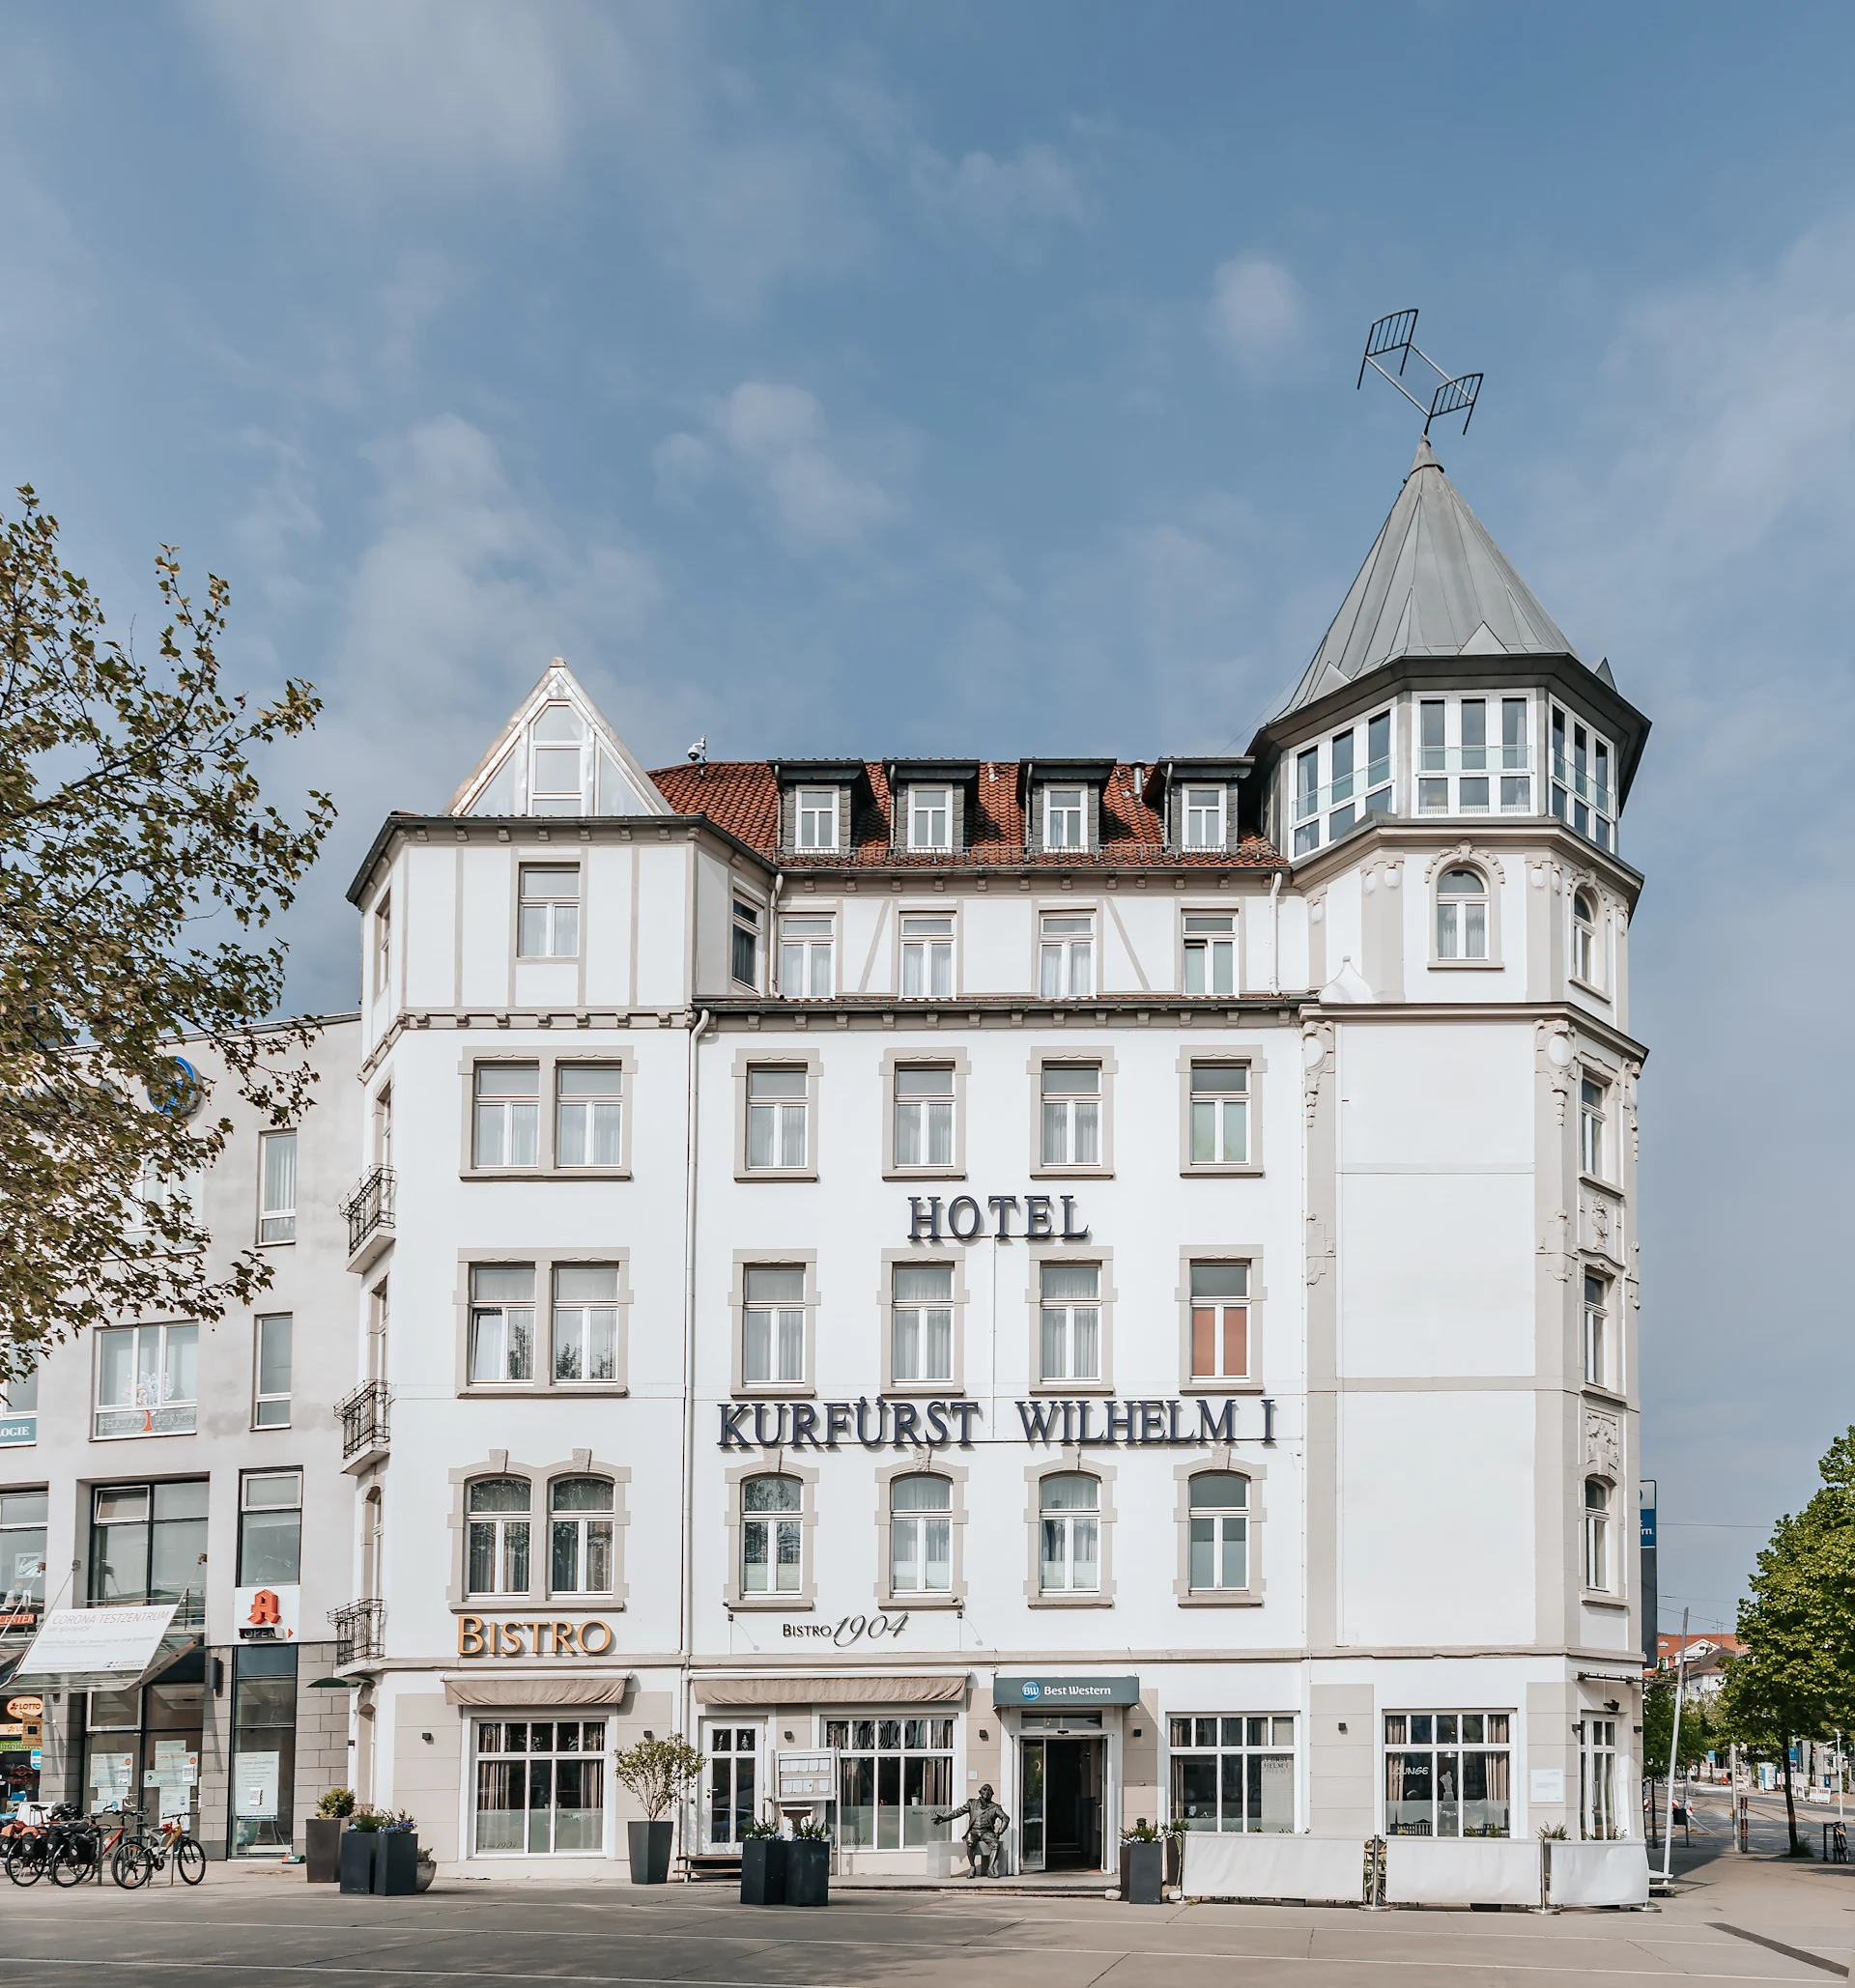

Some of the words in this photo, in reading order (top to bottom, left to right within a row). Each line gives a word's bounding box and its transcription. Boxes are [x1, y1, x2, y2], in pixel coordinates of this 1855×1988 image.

[907, 1195, 1089, 1239] HOTEL
[0, 1426, 30, 1437] OGIE
[716, 1396, 979, 1446] KURFÜRST
[1014, 1400, 1237, 1442] WILHELM
[1261, 1400, 1275, 1440] I
[53, 1614, 96, 1625] CORONA
[99, 1610, 168, 1624] TESTZENTRUM
[783, 1623, 832, 1638] BISTRO
[833, 1612, 909, 1648] 1904
[243, 1628, 276, 1638] OPEN
[457, 1615, 612, 1655] BISTRO
[1024, 1687, 1039, 1695] BW
[1043, 1686, 1067, 1695] Best
[1069, 1686, 1111, 1695] Western
